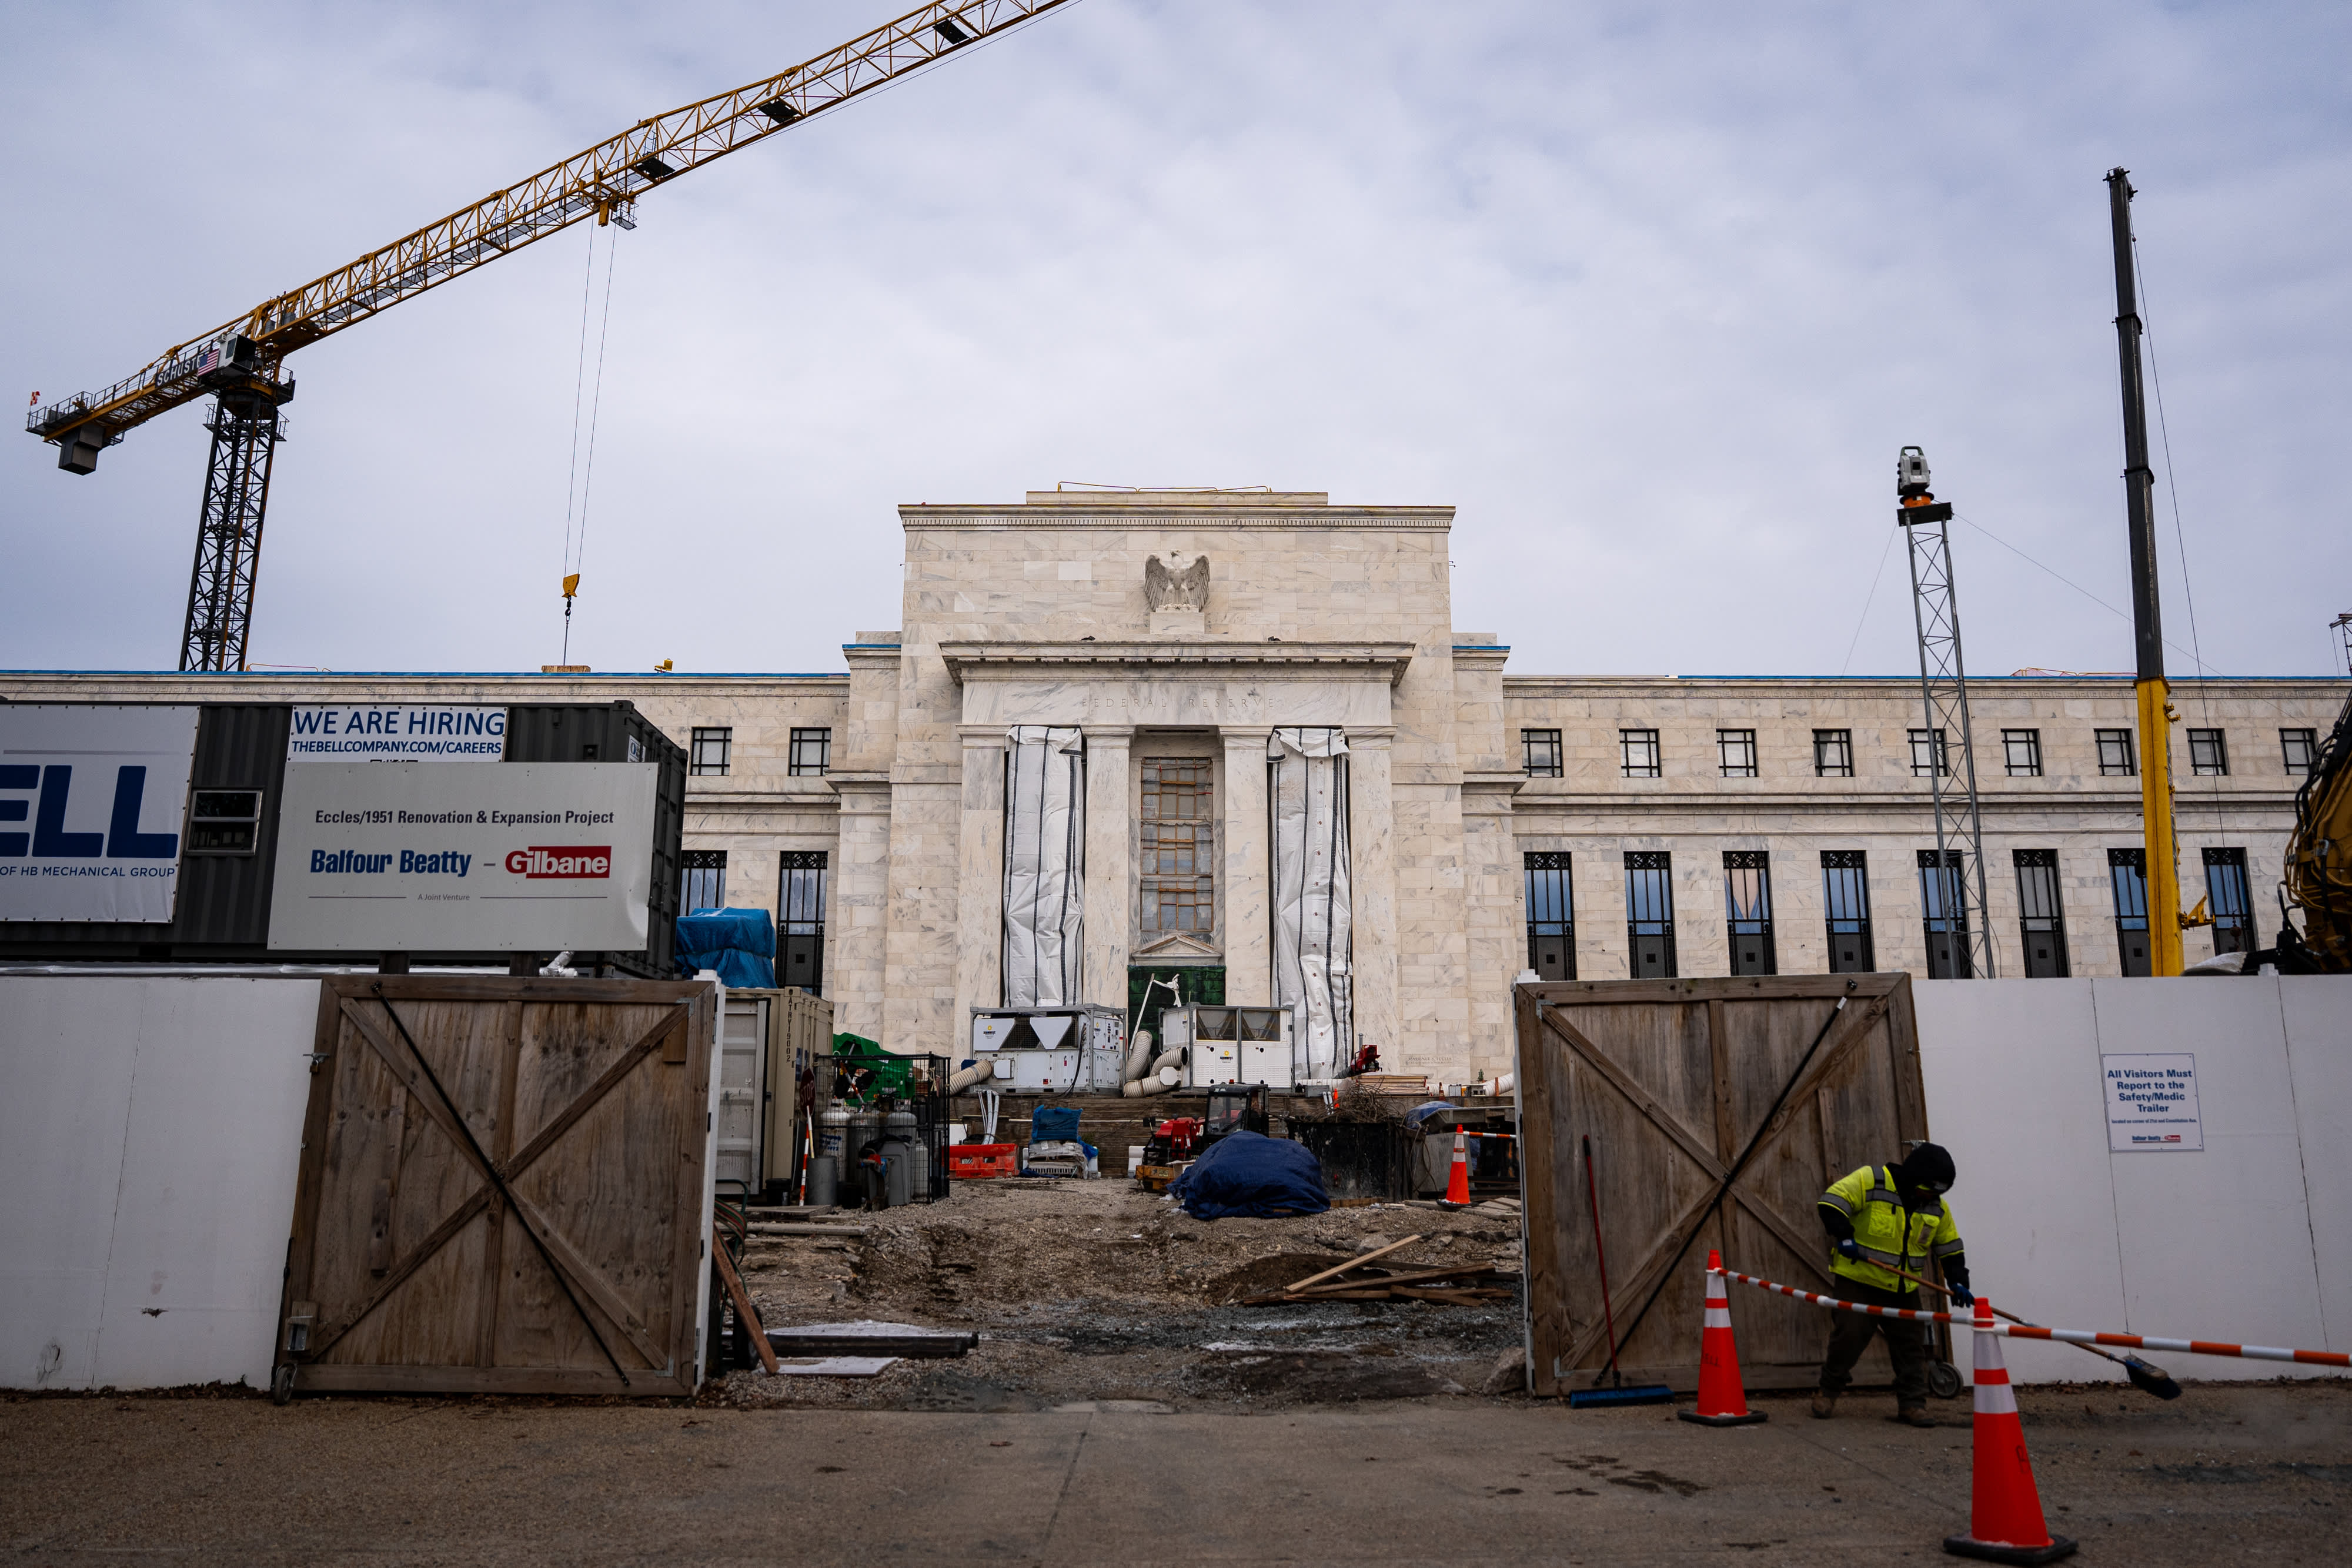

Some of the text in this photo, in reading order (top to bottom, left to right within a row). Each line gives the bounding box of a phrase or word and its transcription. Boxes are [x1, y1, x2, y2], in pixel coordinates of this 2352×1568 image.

[1082, 698, 1273, 707] FEDERAL RESERVE
[295, 711, 505, 735] WE ARE HIRING
[292, 740, 502, 755] THEBELLCOMPANY.COM/CAREERS
[316, 810, 614, 827] Eccles/1951 Renovation & Expansion Project
[310, 850, 393, 873] Balfour
[399, 850, 472, 877] Beatty
[505, 850, 608, 874] Gilbane
[0, 867, 175, 877] OF HB MECHANICAL GROUP
[2166, 1069, 2192, 1077] Must
[2117, 1081, 2151, 1091] Report
[2169, 1081, 2185, 1089] the
[2119, 1092, 2185, 1102] Safety/Medic
[2137, 1104, 2169, 1112] Trailer
